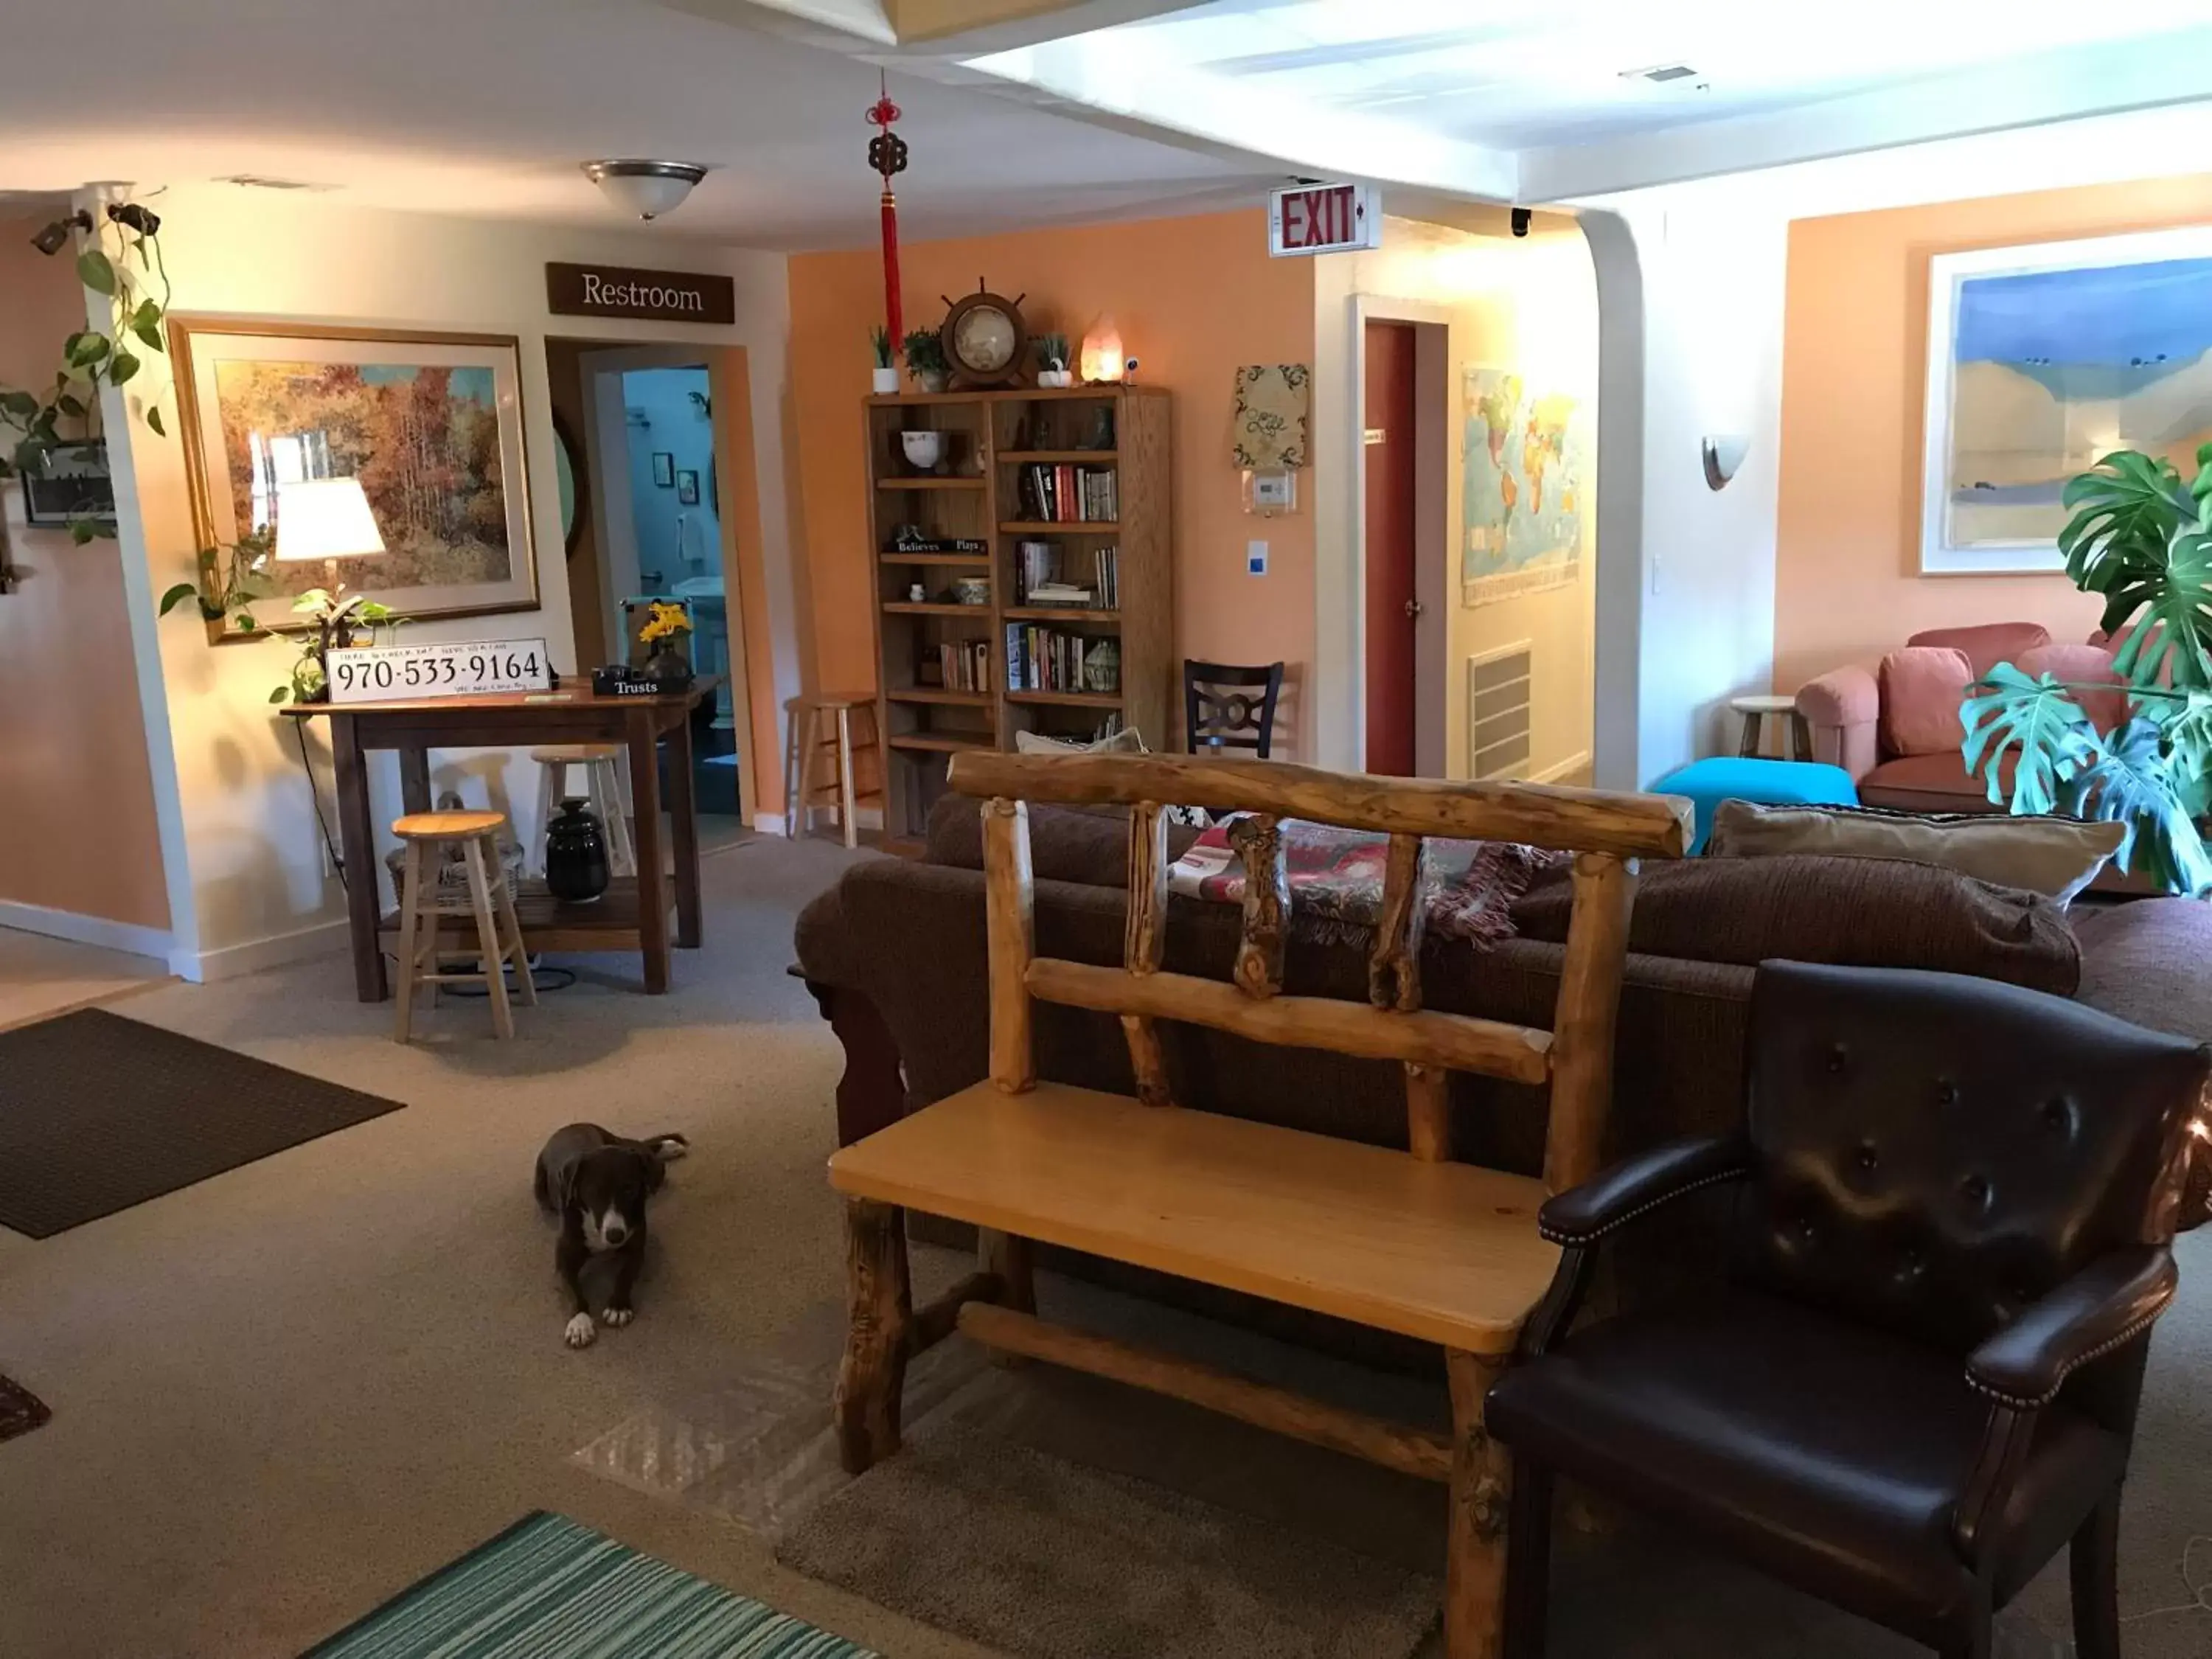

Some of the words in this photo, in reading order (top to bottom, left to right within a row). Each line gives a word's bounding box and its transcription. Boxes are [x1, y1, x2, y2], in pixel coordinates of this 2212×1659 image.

[1281, 186, 1354, 248] EXIT
[581, 274, 703, 310] Restroom
[899, 542, 940, 552] Believes
[956, 540, 978, 551] Plays
[615, 682, 658, 694] Trusts
